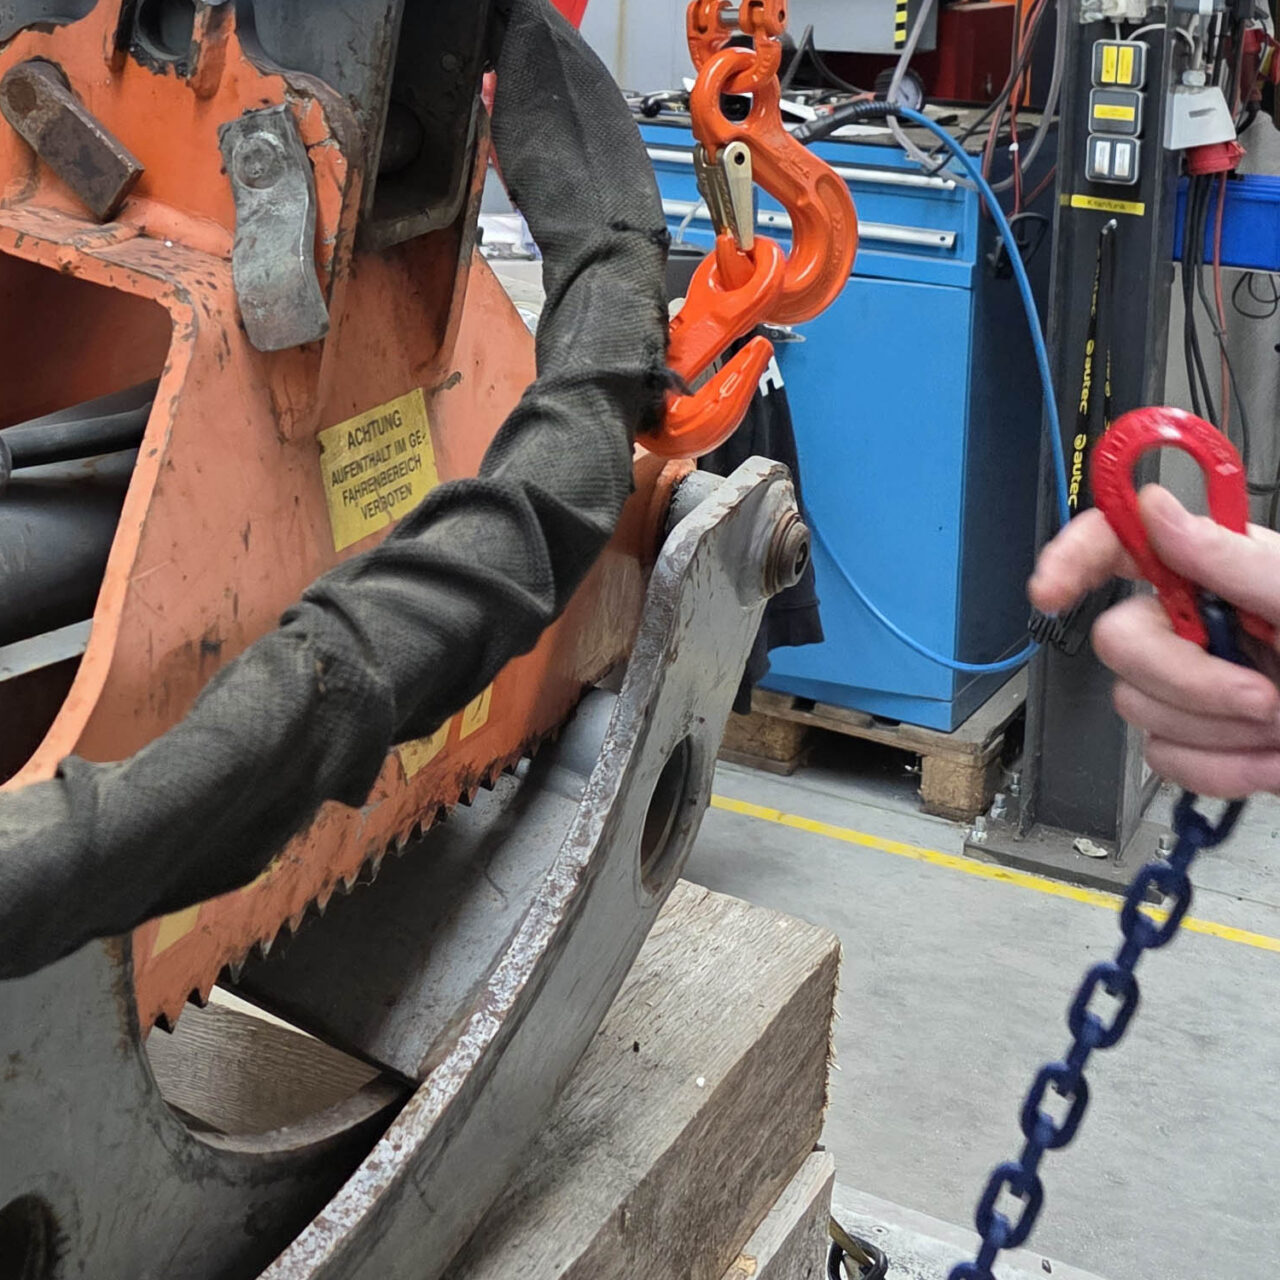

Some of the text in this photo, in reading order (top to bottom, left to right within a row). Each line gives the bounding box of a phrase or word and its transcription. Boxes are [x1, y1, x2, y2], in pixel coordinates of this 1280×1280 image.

[1079, 355, 1092, 415] autec
[347, 409, 403, 450] ACHTUNG
[331, 443, 392, 488] AUFENTHALT
[394, 436, 408, 456] IM
[342, 453, 422, 508] FAHRENBEREICH
[1067, 451, 1084, 510] autec
[360, 481, 413, 521] VERBOTEN
